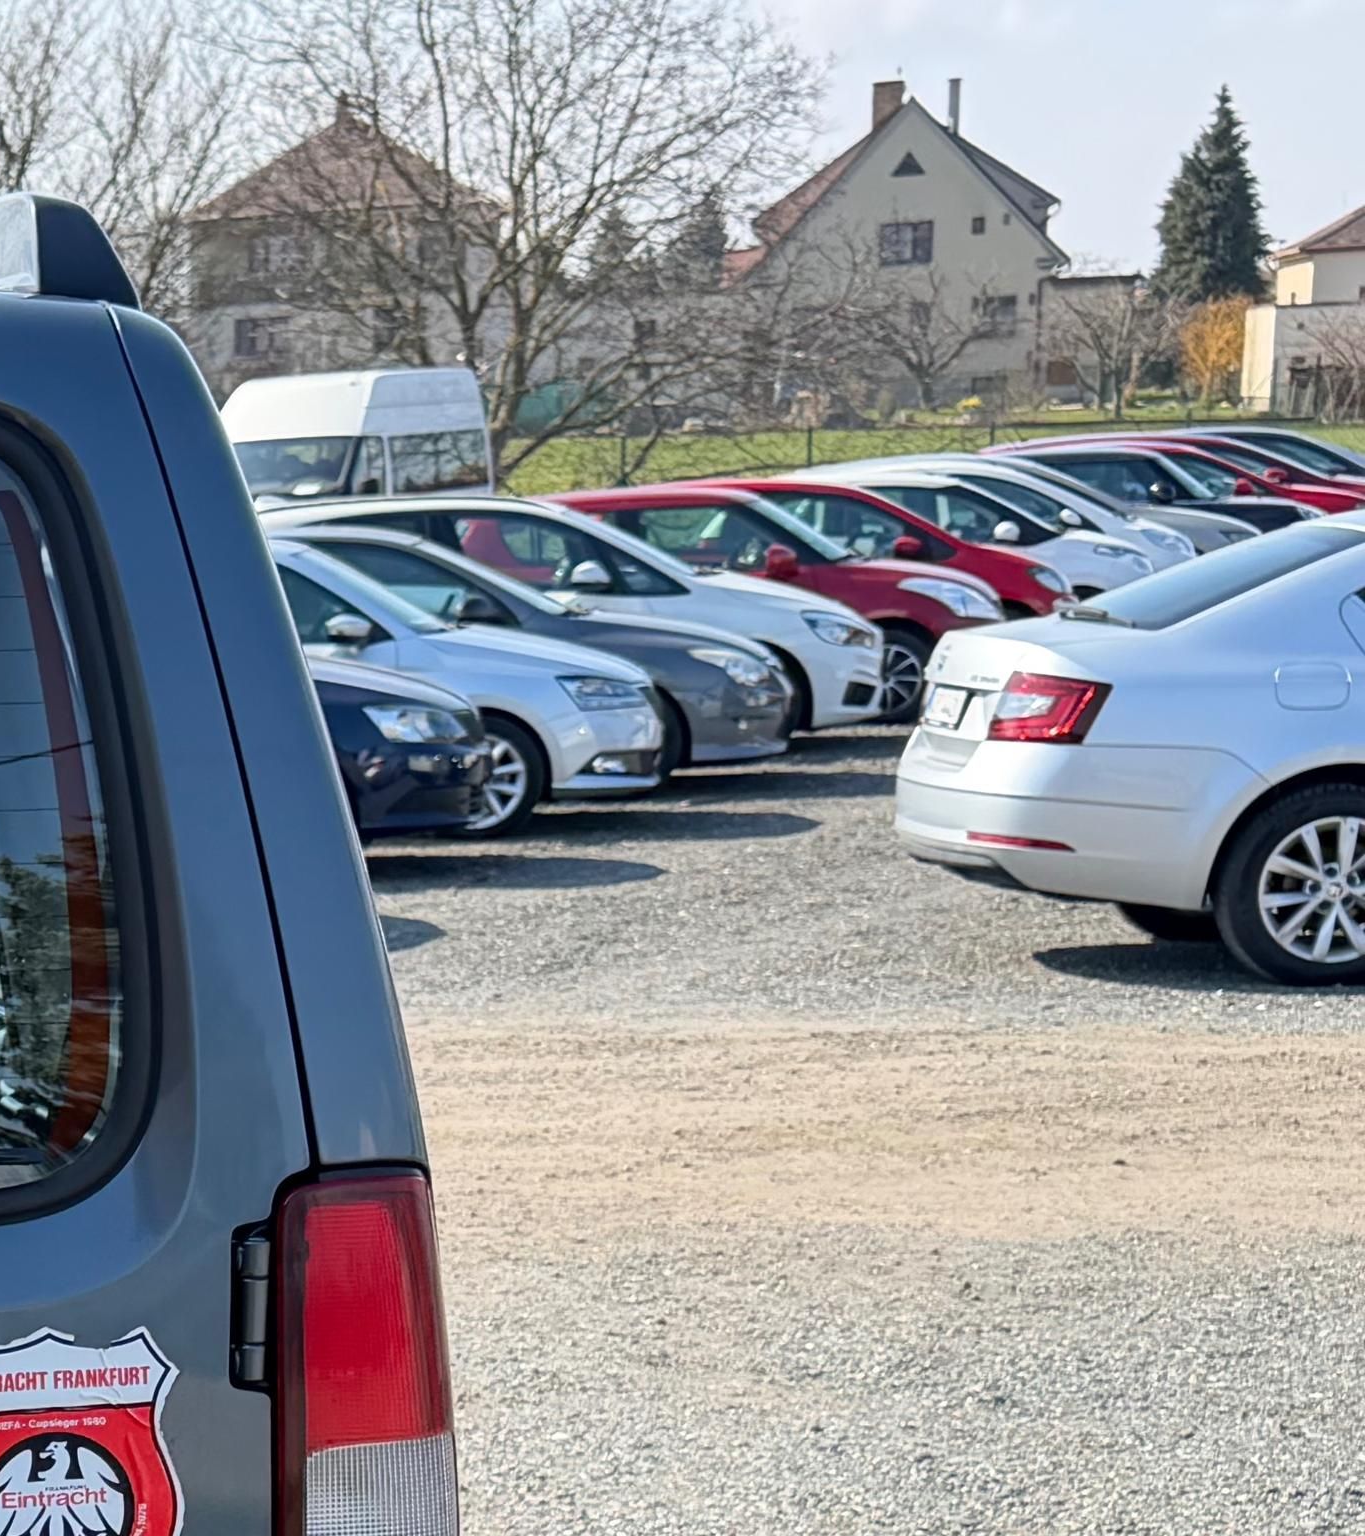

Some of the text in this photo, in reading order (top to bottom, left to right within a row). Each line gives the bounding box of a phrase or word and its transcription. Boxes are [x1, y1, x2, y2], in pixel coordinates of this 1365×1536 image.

[53, 1366, 151, 1390] FRANKFURT
[82, 1416, 107, 1426] 1980
[1, 1487, 107, 1509] Eintracht
